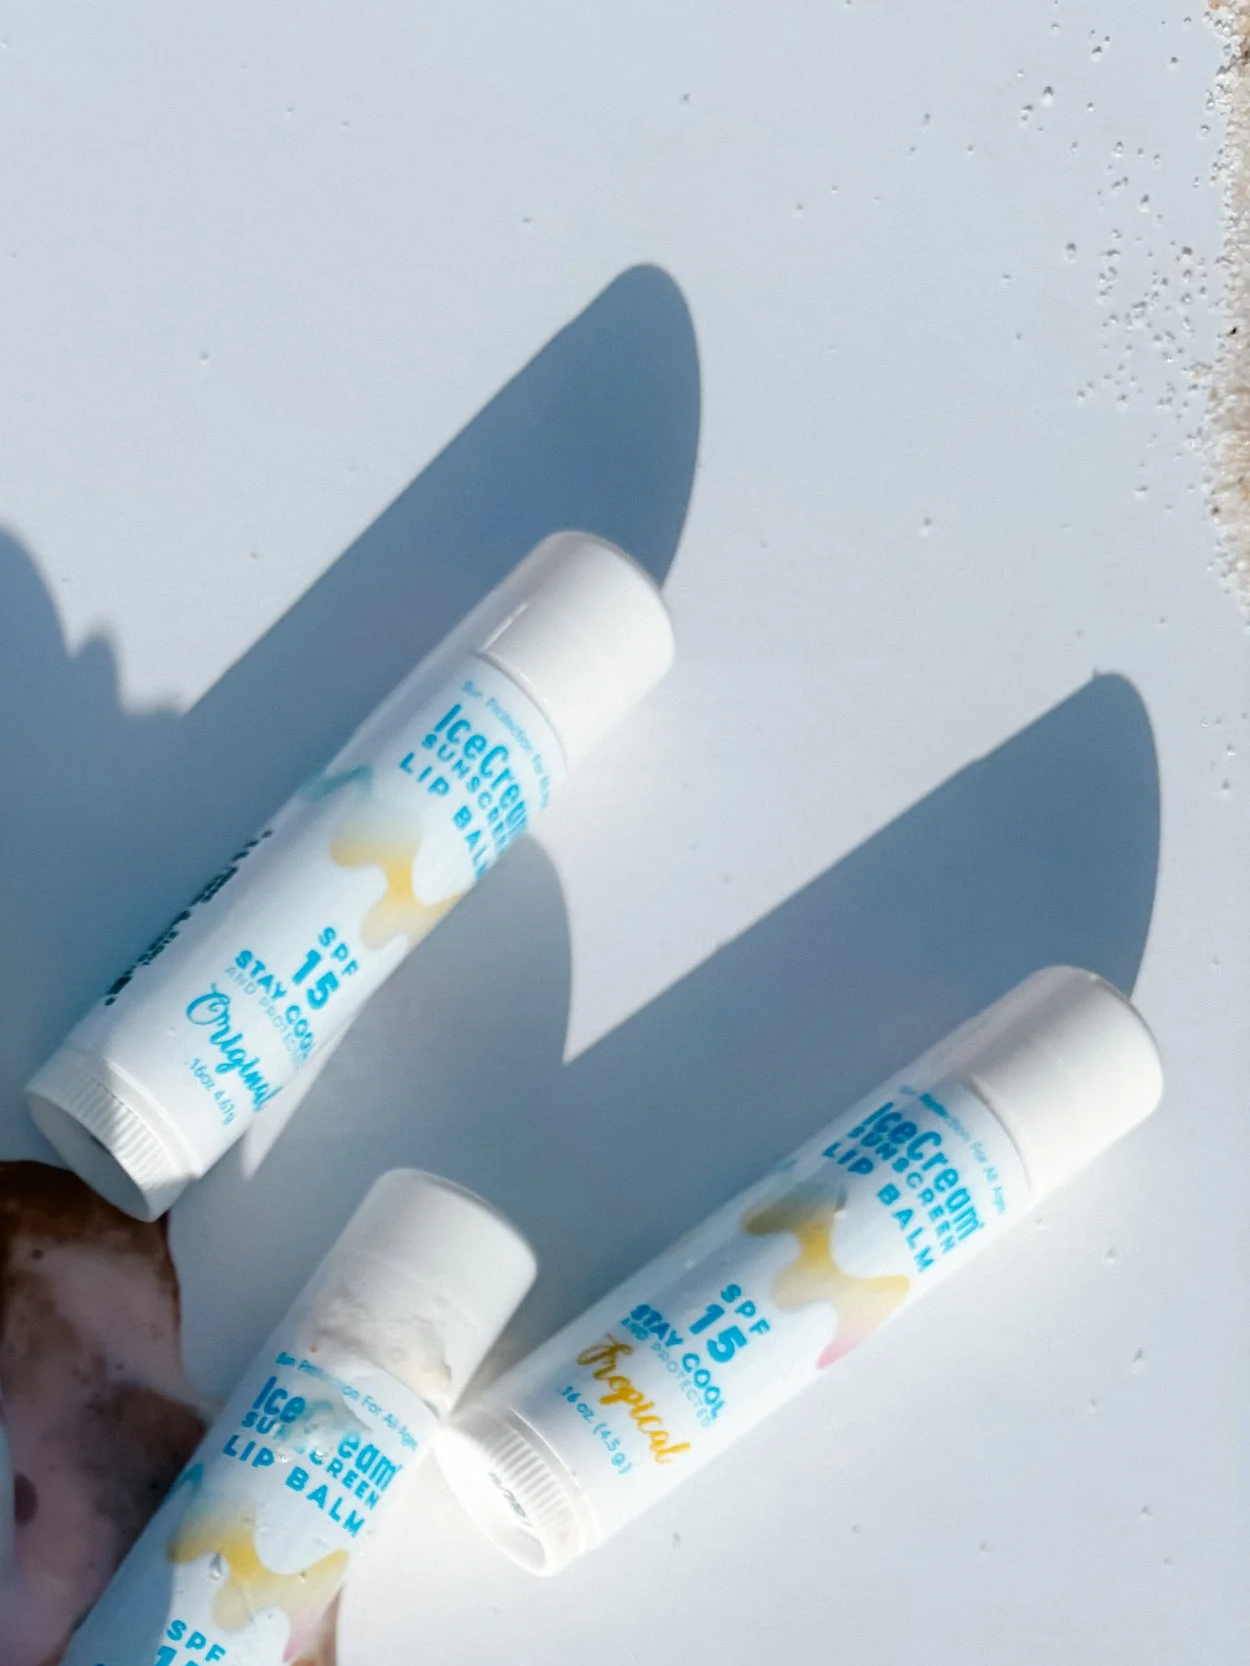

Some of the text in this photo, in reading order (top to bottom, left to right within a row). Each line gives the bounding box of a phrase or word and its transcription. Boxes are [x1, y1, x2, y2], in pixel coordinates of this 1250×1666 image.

[398, 751, 451, 797] LIP
[234, 948, 287, 1003] STAY
[291, 948, 341, 1011] 15
[316, 925, 361, 978] SPF
[185, 982, 285, 1113] Original
[820, 1141, 936, 1273] LIP BALM
[846, 1124, 957, 1254] SUNSCREEN
[861, 1101, 981, 1243] IceCream
[688, 1303, 748, 1365] 15
[720, 1282, 771, 1337] SPF
[576, 1332, 692, 1466] Tropical
[629, 1303, 729, 1420] STAY COOL
[222, 1434, 366, 1537] LIP BALM
[165, 1618, 226, 1663] SPF
